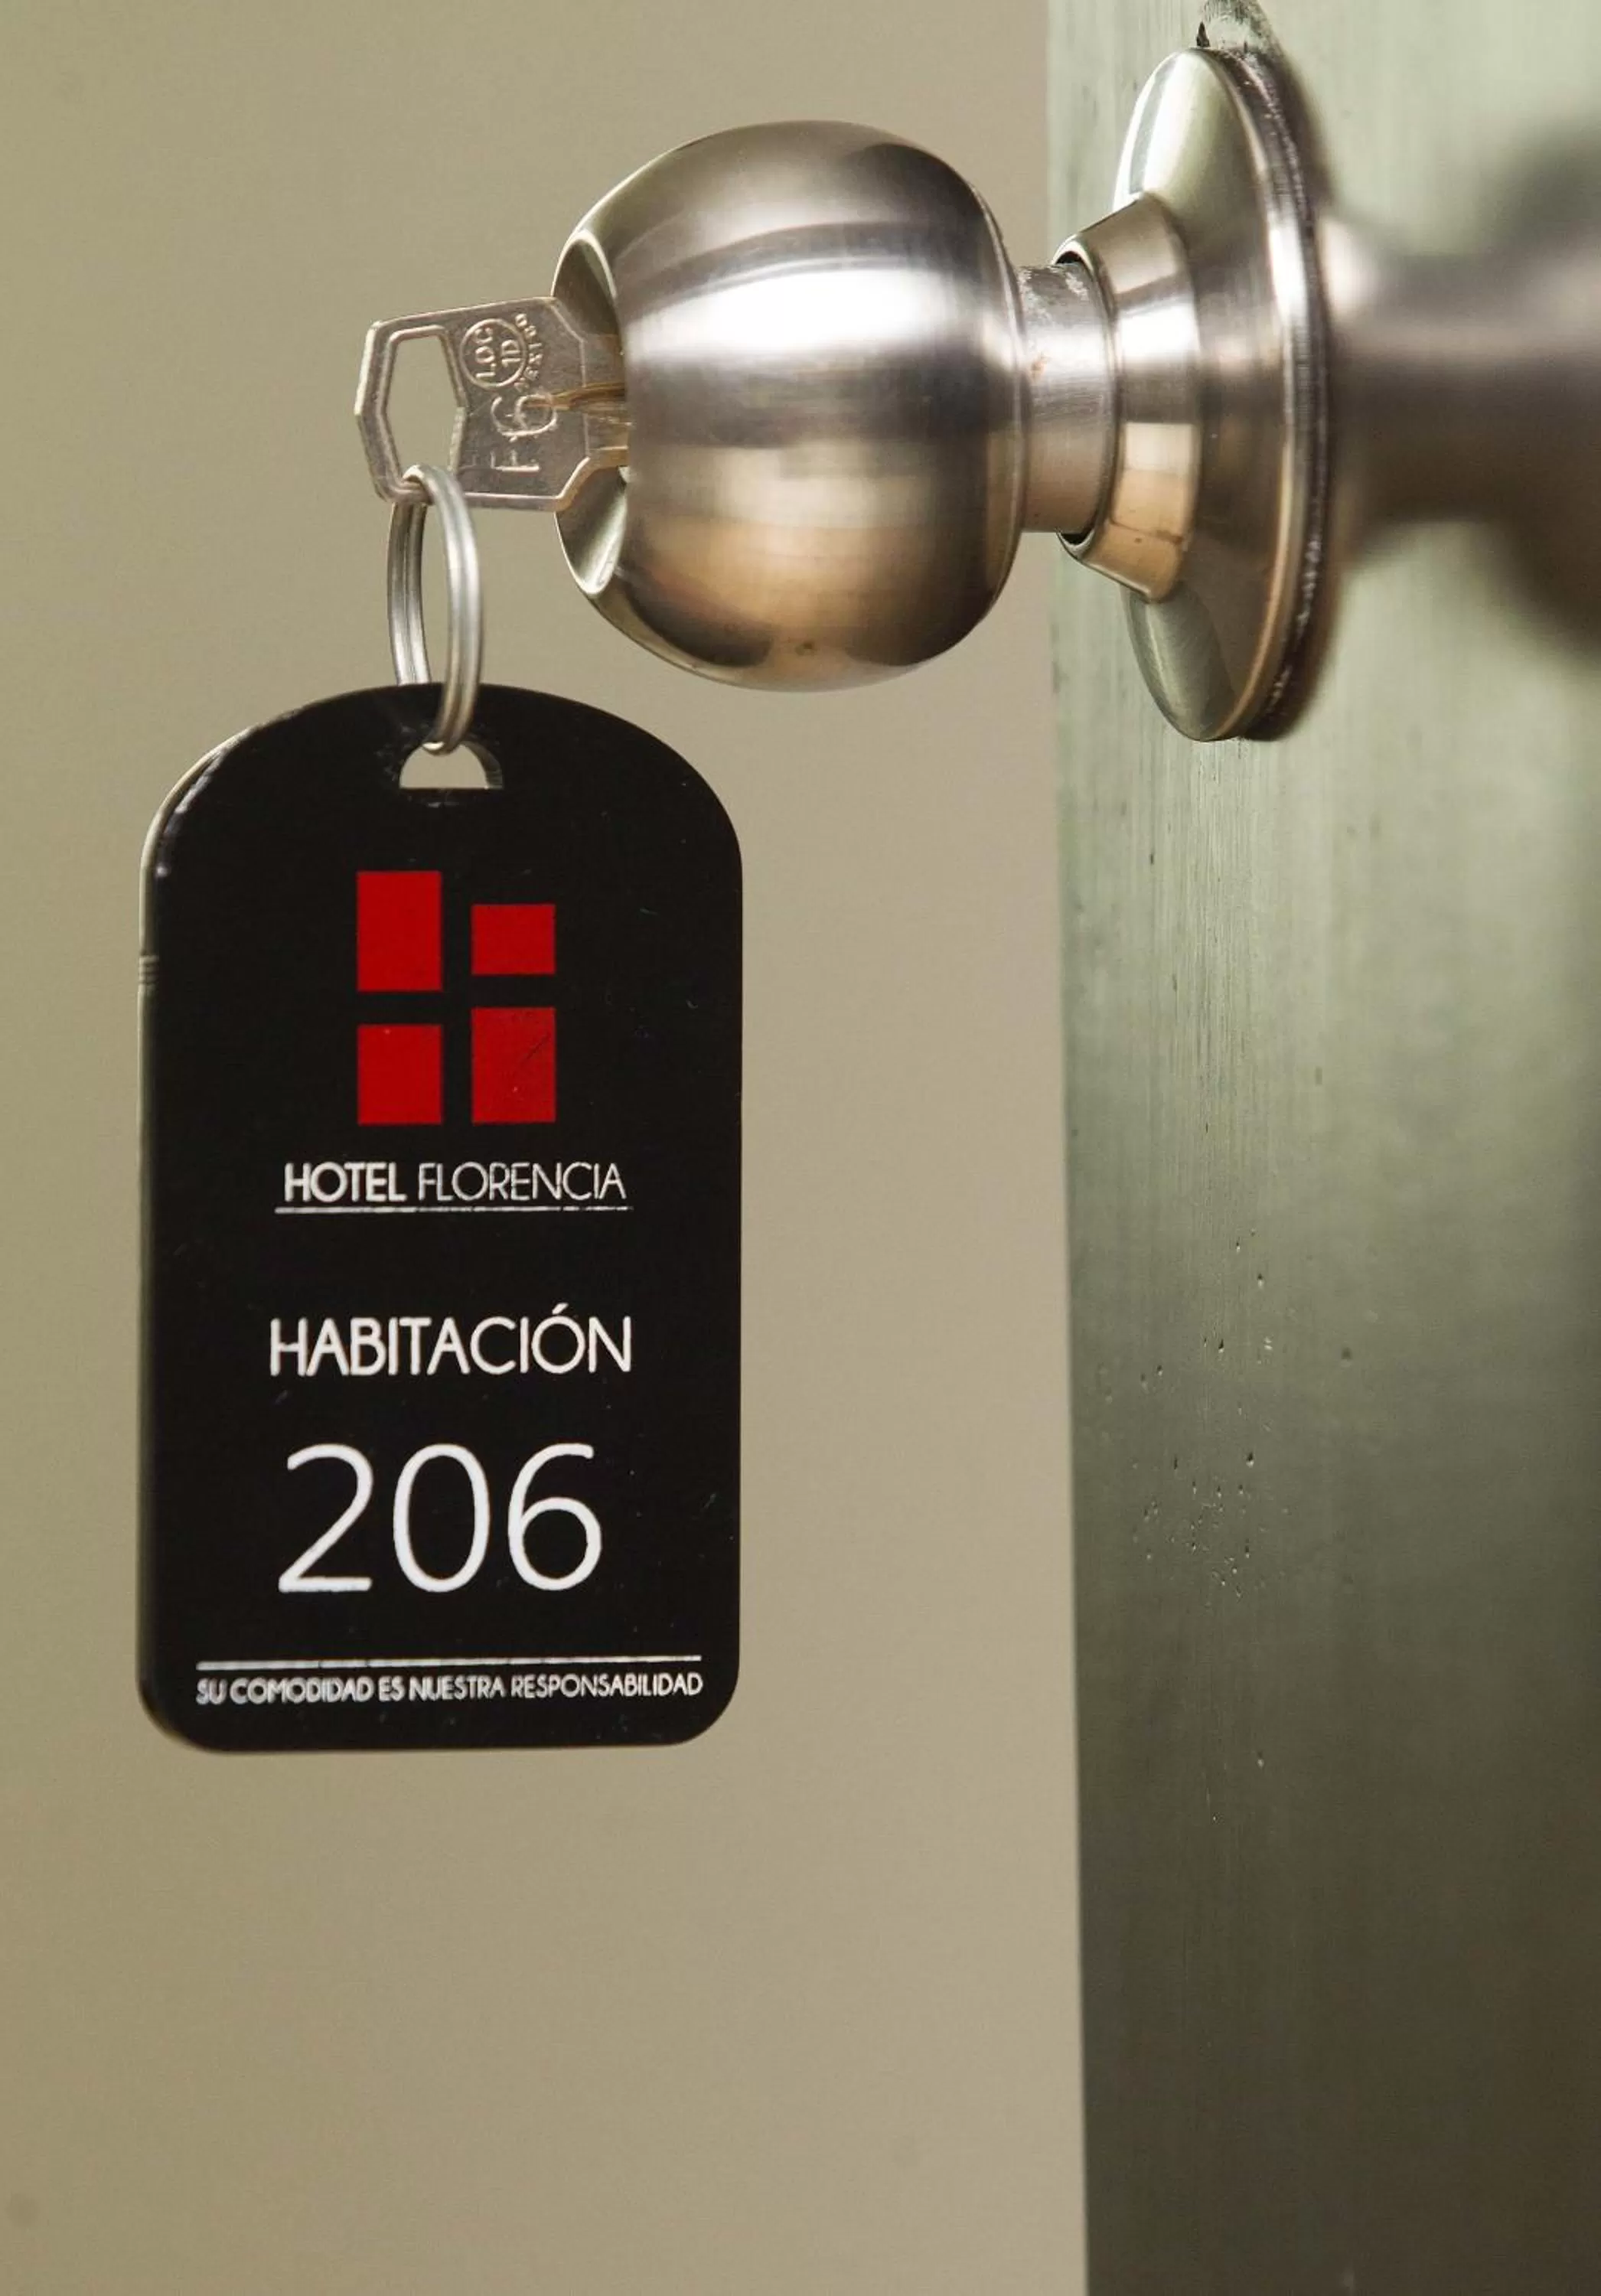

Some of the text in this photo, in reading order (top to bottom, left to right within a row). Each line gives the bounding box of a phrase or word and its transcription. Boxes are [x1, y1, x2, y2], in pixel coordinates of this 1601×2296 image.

[474, 327, 497, 379] LOC
[284, 1161, 627, 1202] HOTEL FLORENCIA
[269, 1302, 632, 1377] HABITACIÓN
[278, 1443, 602, 1593] 206
[195, 1671, 704, 1705] SU COMODIDAD ES NUESTRA RESPONSABILIDAD
